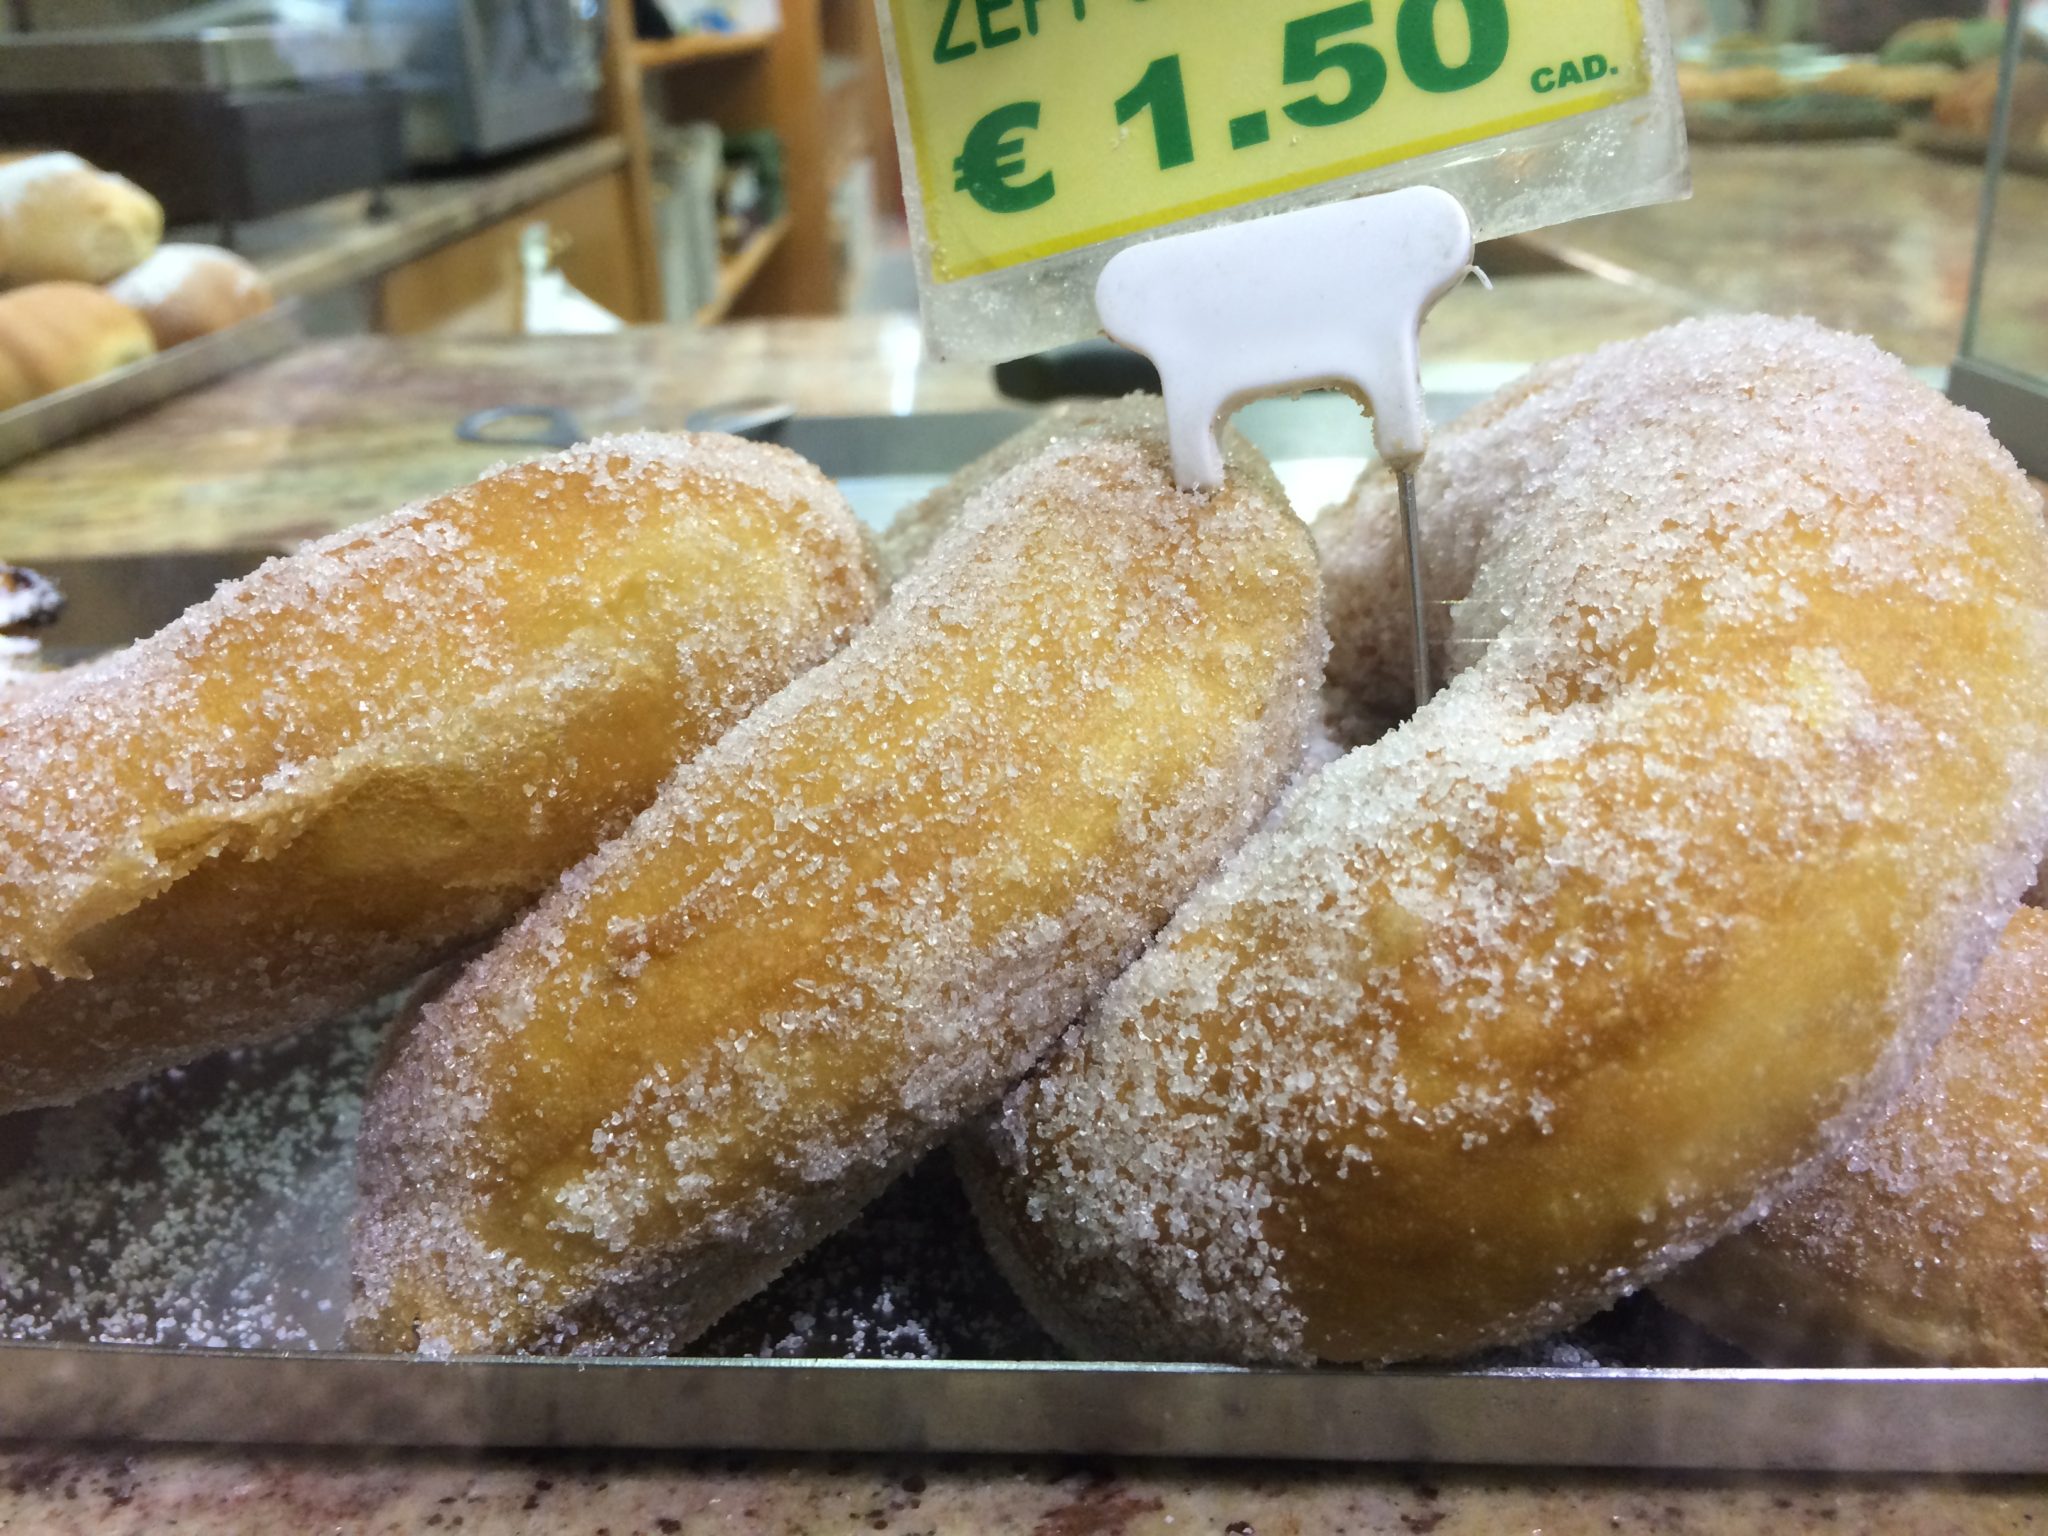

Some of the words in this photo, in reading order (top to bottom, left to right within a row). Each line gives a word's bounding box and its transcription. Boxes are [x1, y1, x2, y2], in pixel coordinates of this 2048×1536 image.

[953, 101, 1056, 214] €
[1114, 0, 1510, 171] 1.50
[1530, 55, 1619, 94] CAD.
